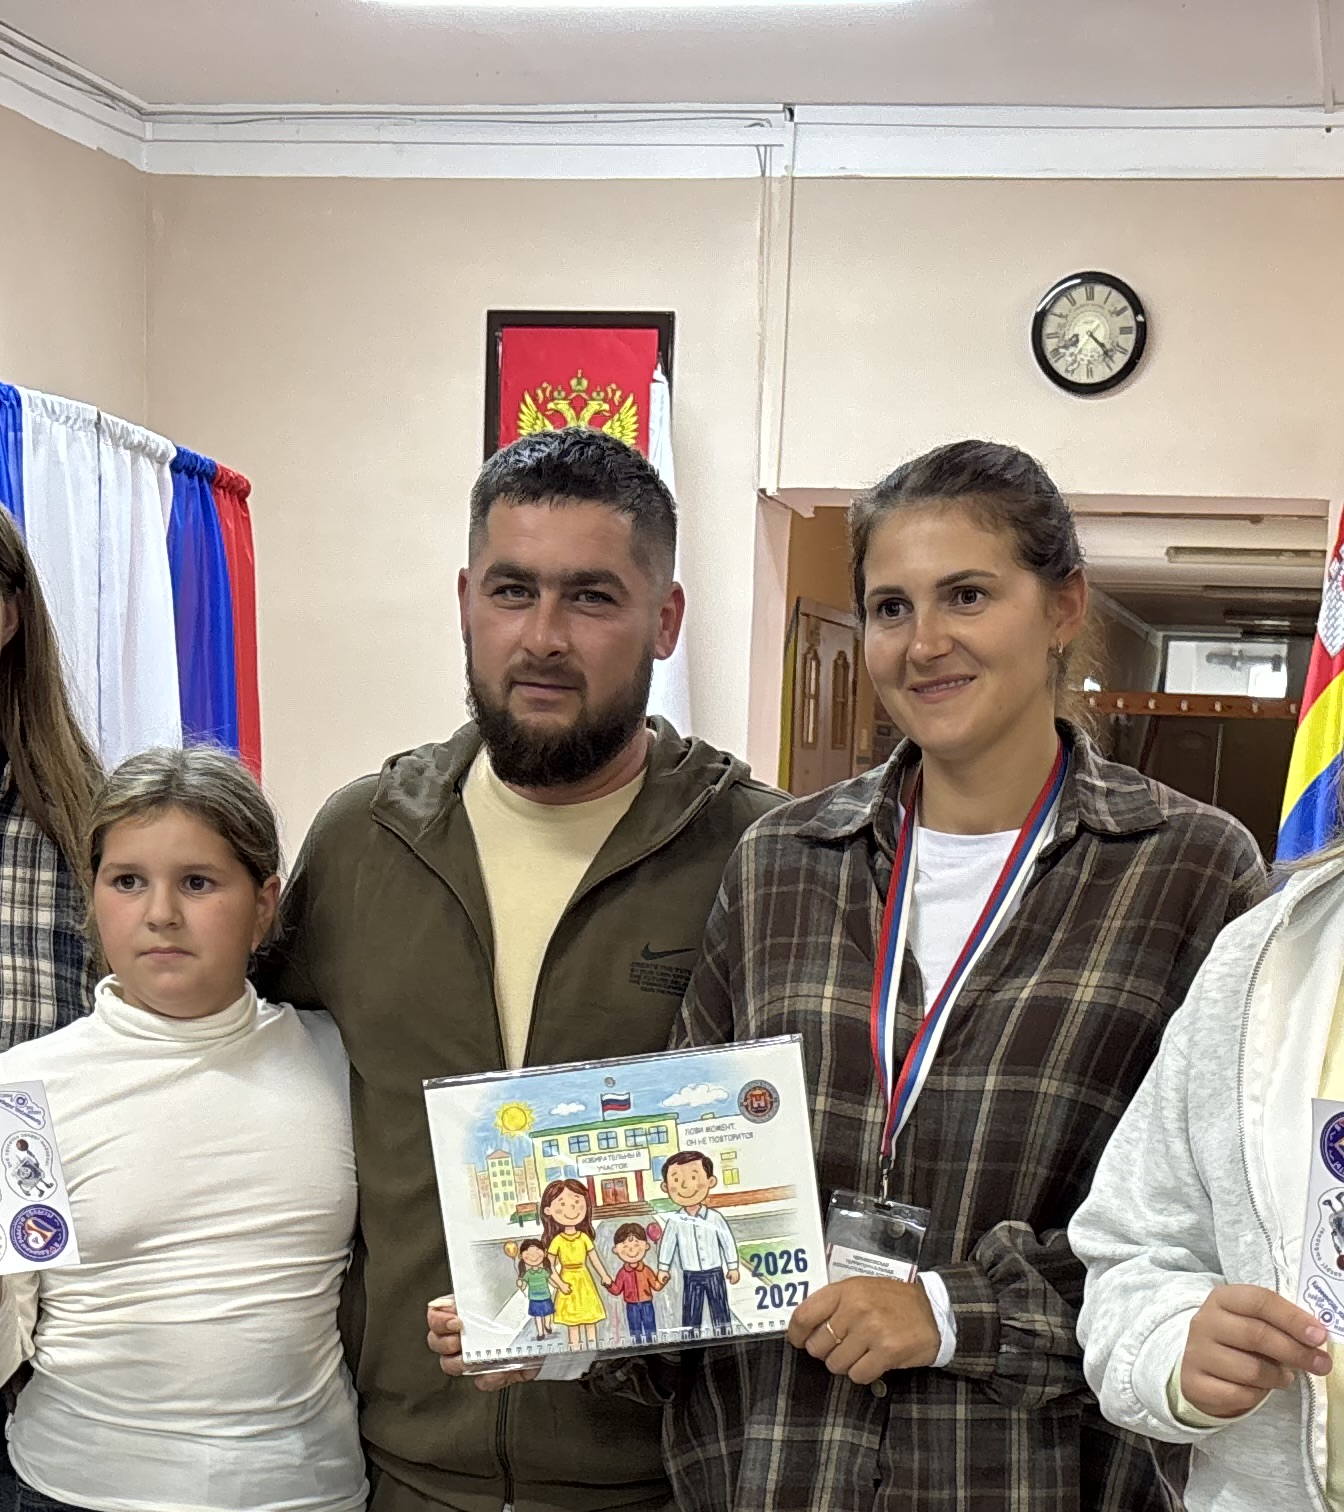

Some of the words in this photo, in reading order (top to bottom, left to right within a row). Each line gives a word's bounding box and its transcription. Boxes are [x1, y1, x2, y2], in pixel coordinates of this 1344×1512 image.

[582, 1151, 641, 1166] ИЗБИРАТЕЛЬНЫЙ
[597, 1163, 628, 1173] УЧАСТОК
[750, 1248, 808, 1277] 2026
[754, 1281, 809, 1310] 2027
